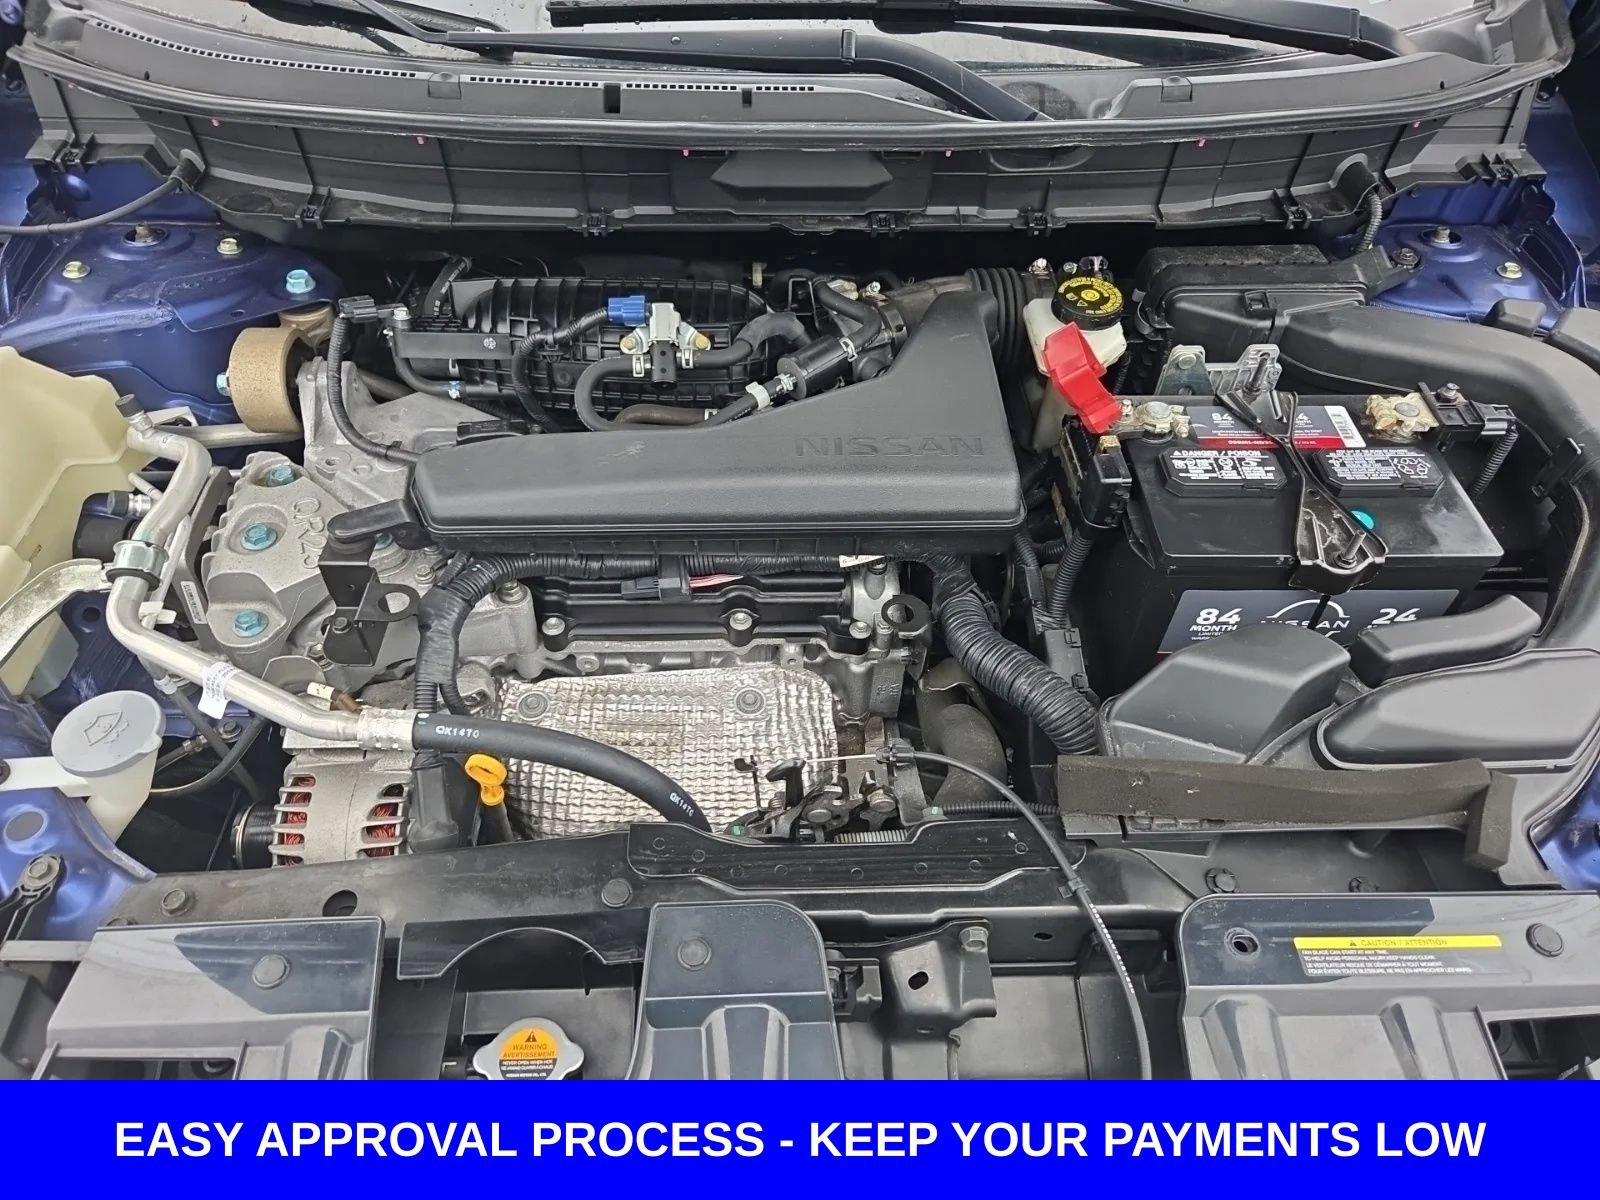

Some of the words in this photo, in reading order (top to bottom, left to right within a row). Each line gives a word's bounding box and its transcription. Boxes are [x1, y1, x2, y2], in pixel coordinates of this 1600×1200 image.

[795, 436, 985, 456] NISSAN
[1196, 608, 1243, 624] 84
[1371, 607, 1421, 624] 24
[1405, 938, 1448, 946] ATTENTION
